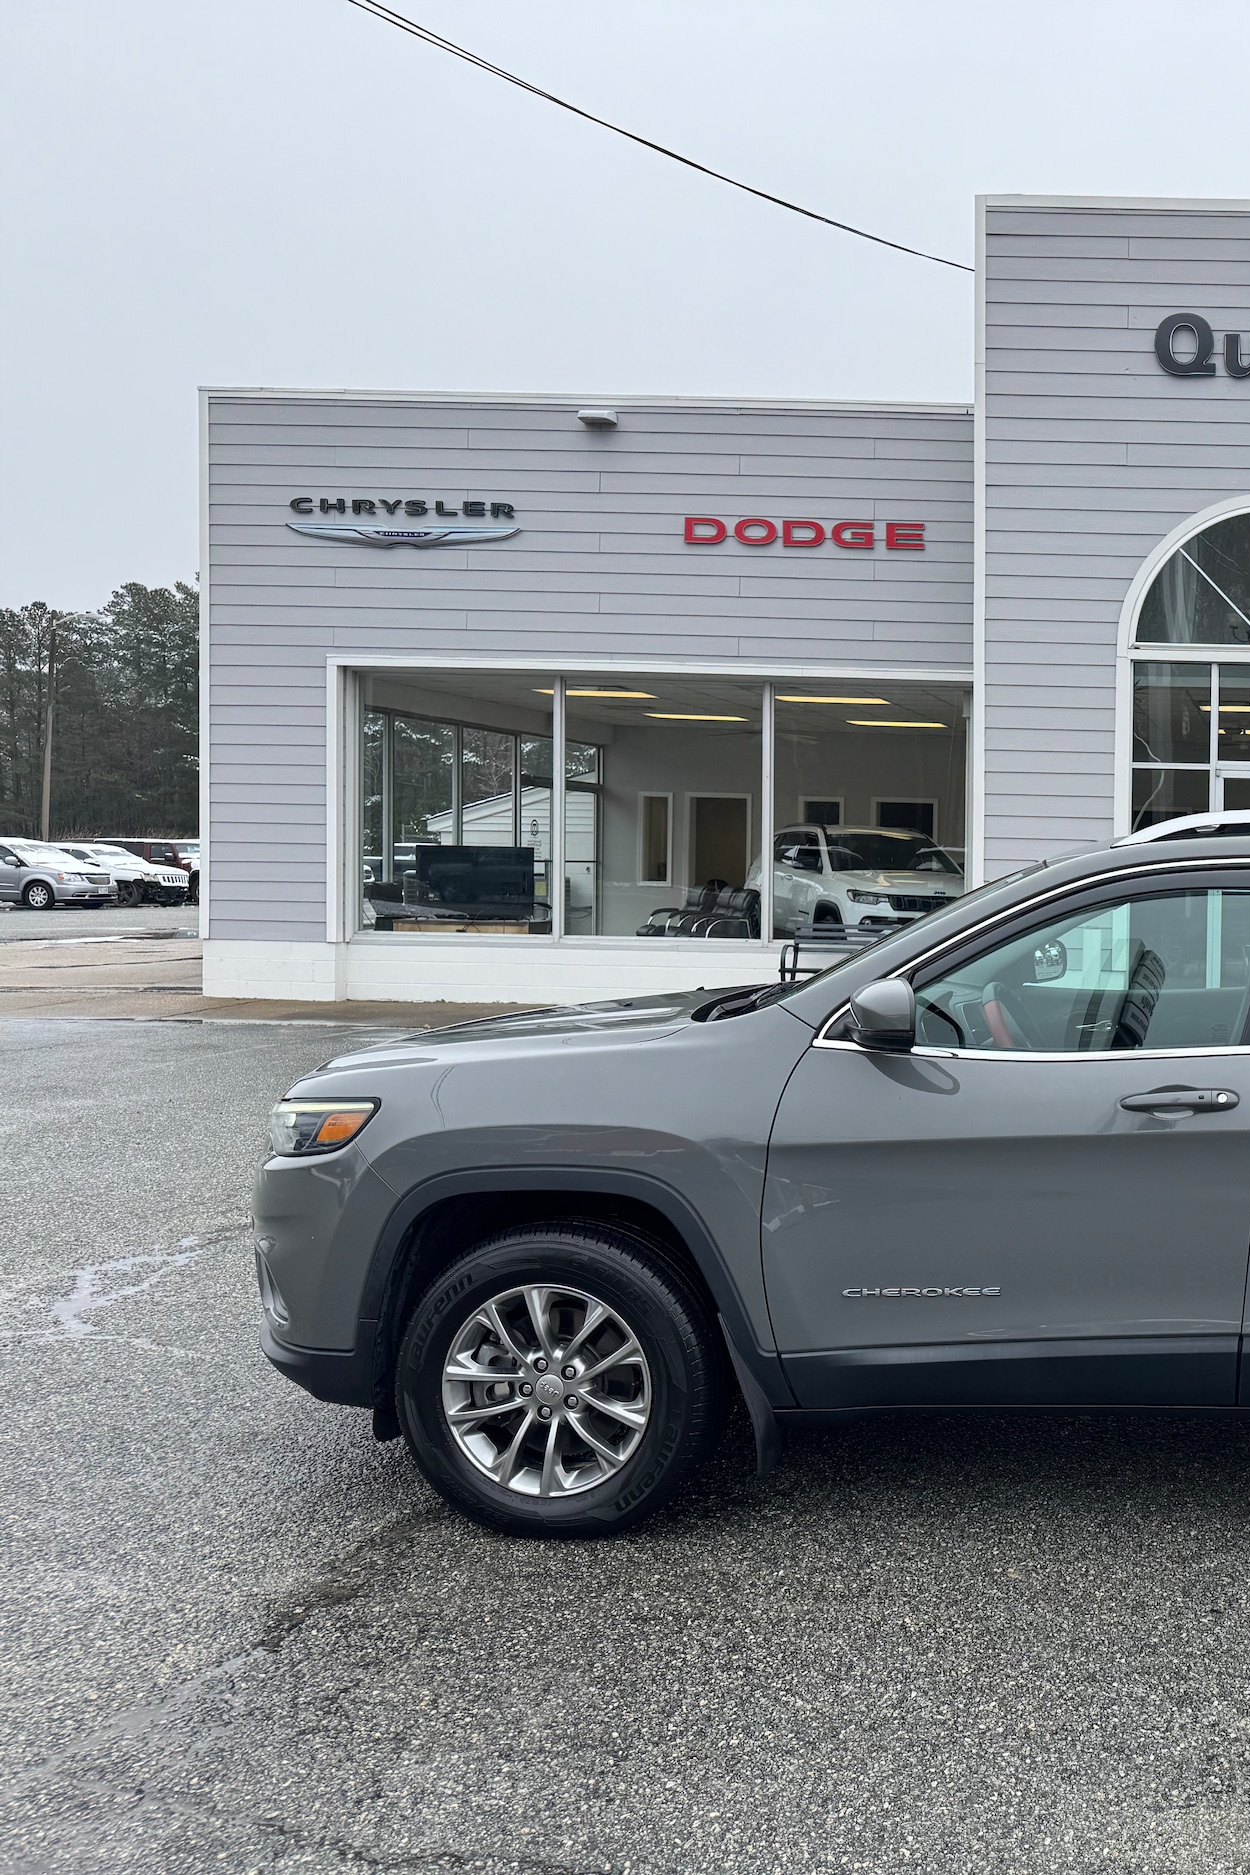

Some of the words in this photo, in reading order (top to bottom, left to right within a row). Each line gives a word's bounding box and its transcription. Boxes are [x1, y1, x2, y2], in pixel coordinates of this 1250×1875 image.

[290, 497, 515, 518] CHRYSLER
[684, 517, 926, 550] DODGE
[842, 1287, 1001, 1297] CHEROKEE
[539, 1381, 560, 1397] Jeep
